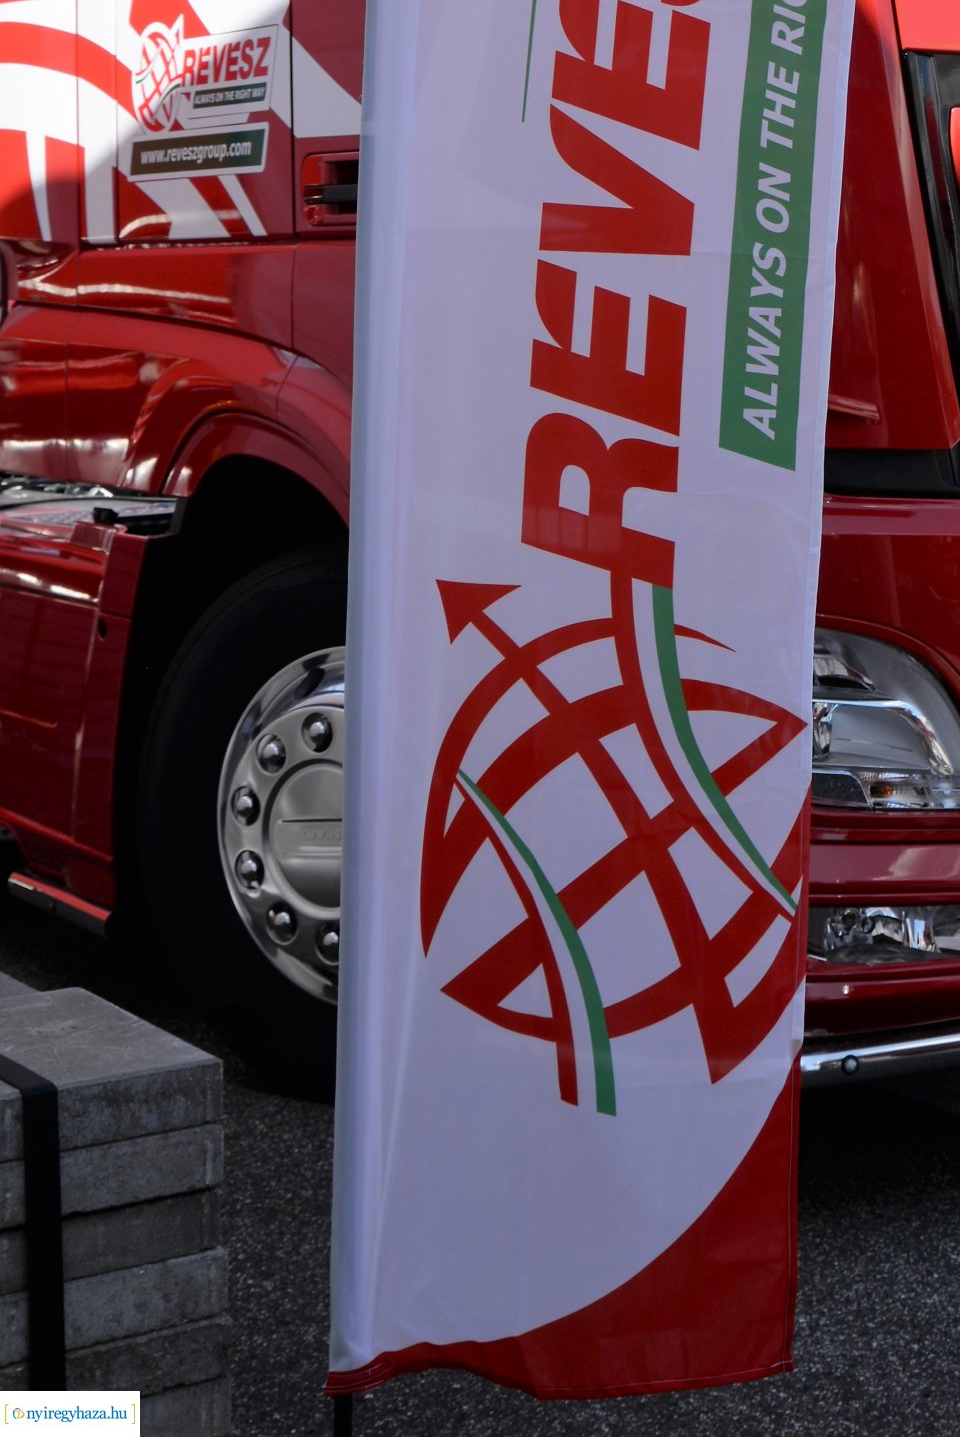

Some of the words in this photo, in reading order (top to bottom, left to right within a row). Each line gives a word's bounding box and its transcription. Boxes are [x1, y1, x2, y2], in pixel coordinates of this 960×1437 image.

[182, 37, 271, 87] REVESZ
[252, 86, 265, 98] WAY
[760, 61, 800, 149] THE
[140, 141, 251, 164] www.reveszgroup.com
[755, 162, 791, 233] ON
[743, 242, 787, 440] ALWAYS
